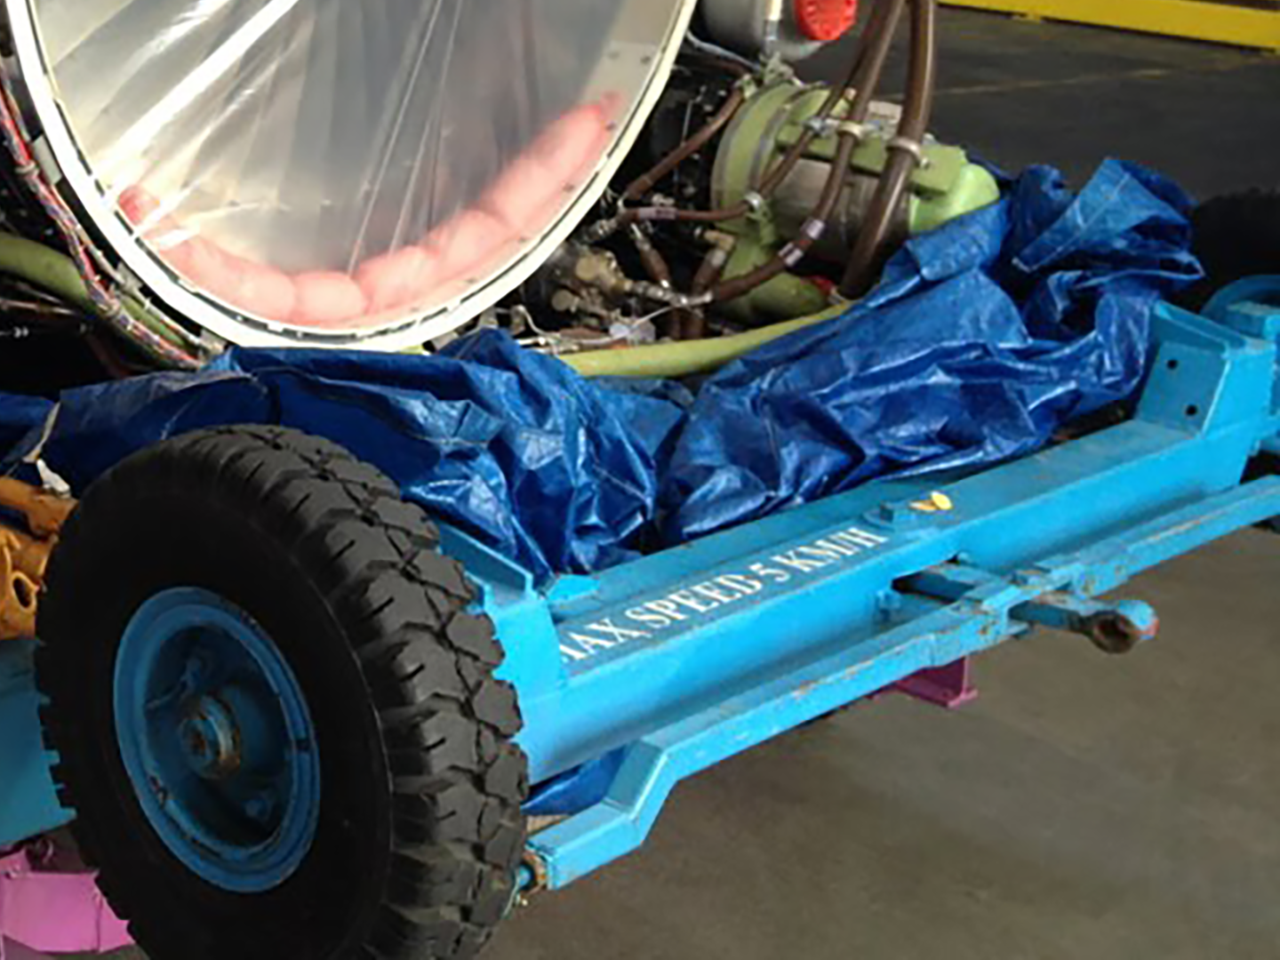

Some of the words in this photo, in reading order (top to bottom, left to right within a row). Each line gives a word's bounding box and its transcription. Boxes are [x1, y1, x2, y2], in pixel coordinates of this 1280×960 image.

[624, 573, 763, 629] SPEED
[750, 562, 791, 583] 5
[771, 527, 889, 573] KM/H
